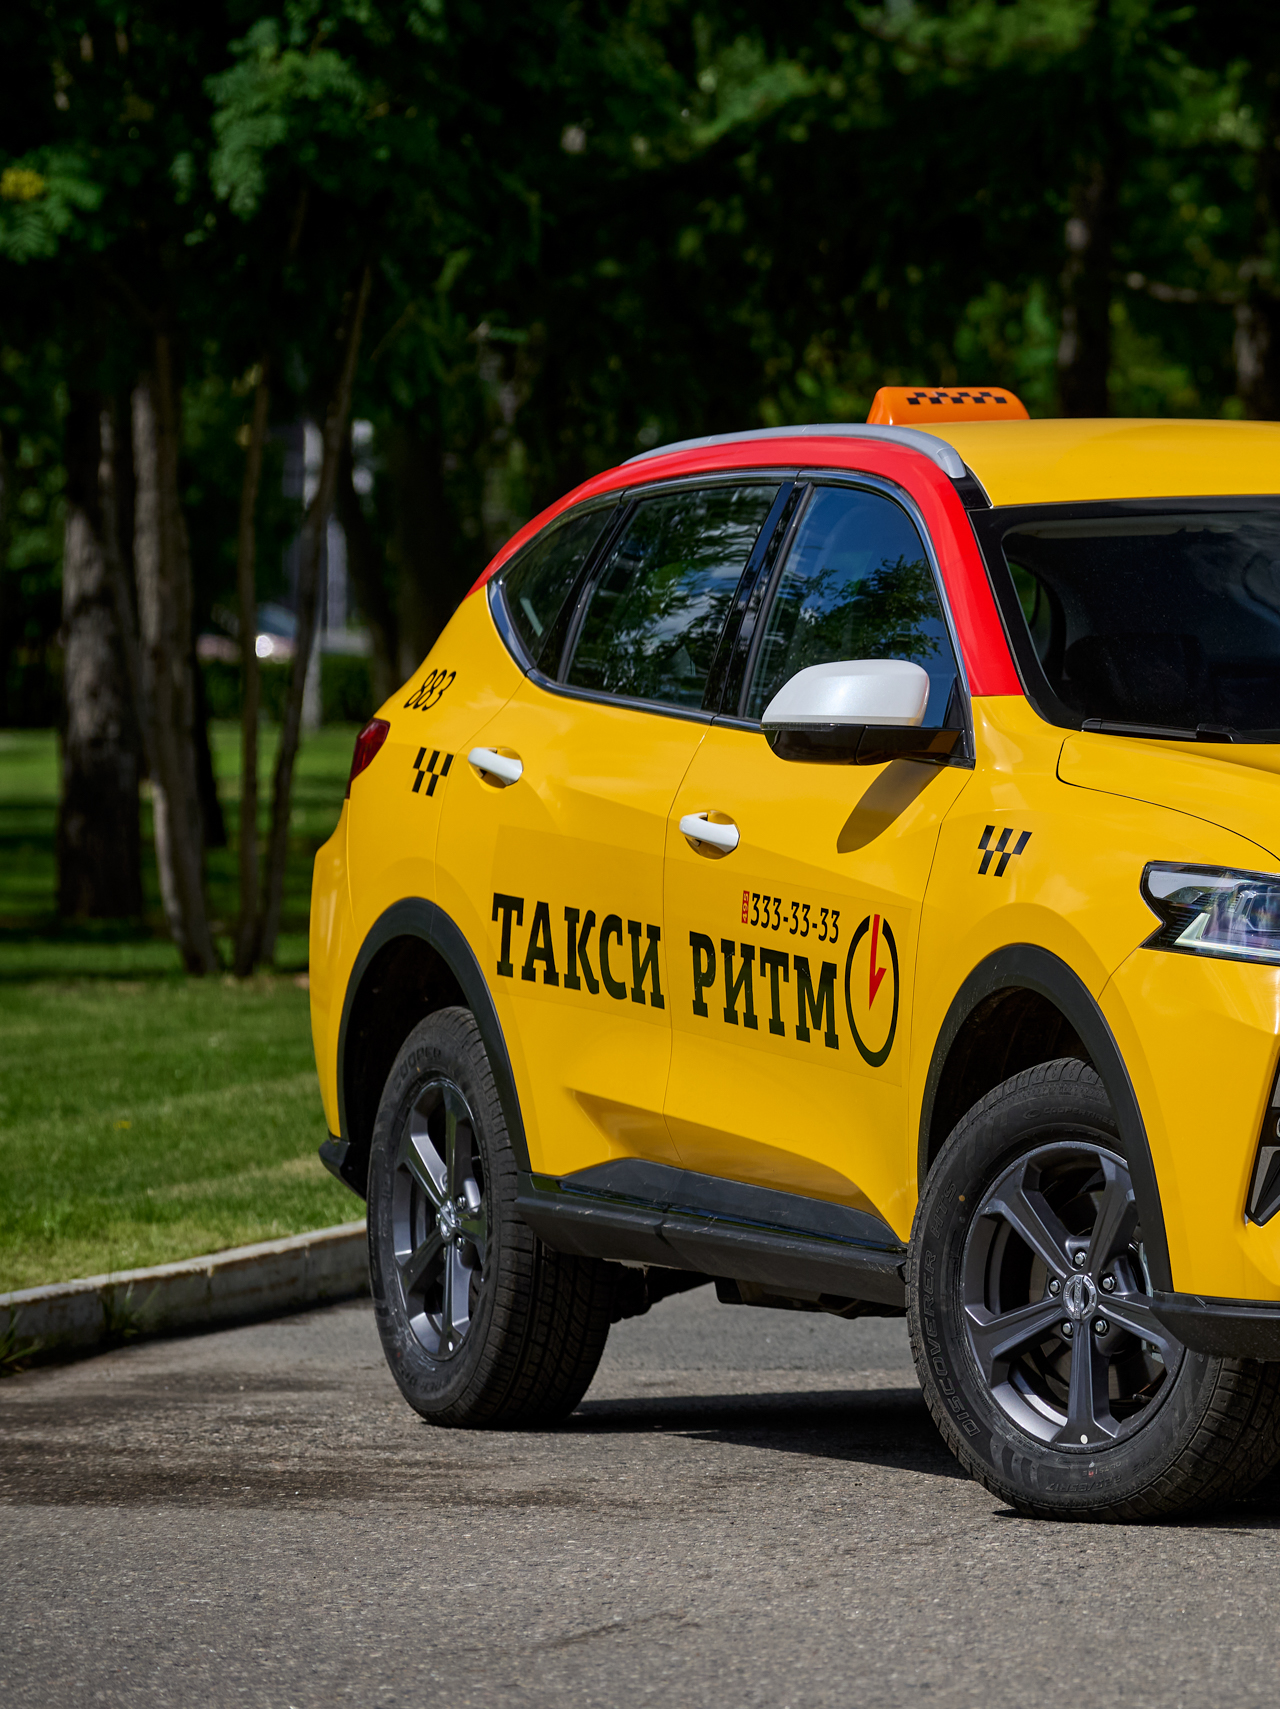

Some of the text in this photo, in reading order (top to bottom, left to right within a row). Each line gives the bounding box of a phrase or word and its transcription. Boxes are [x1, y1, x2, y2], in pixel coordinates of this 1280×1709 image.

[403, 668, 456, 712] 883
[742, 891, 750, 923] 495
[750, 892, 841, 944] 333-33-33
[491, 892, 839, 1050] ТАКСИ РИТМ
[924, 1179, 981, 1438] DISCOVERER HTS
